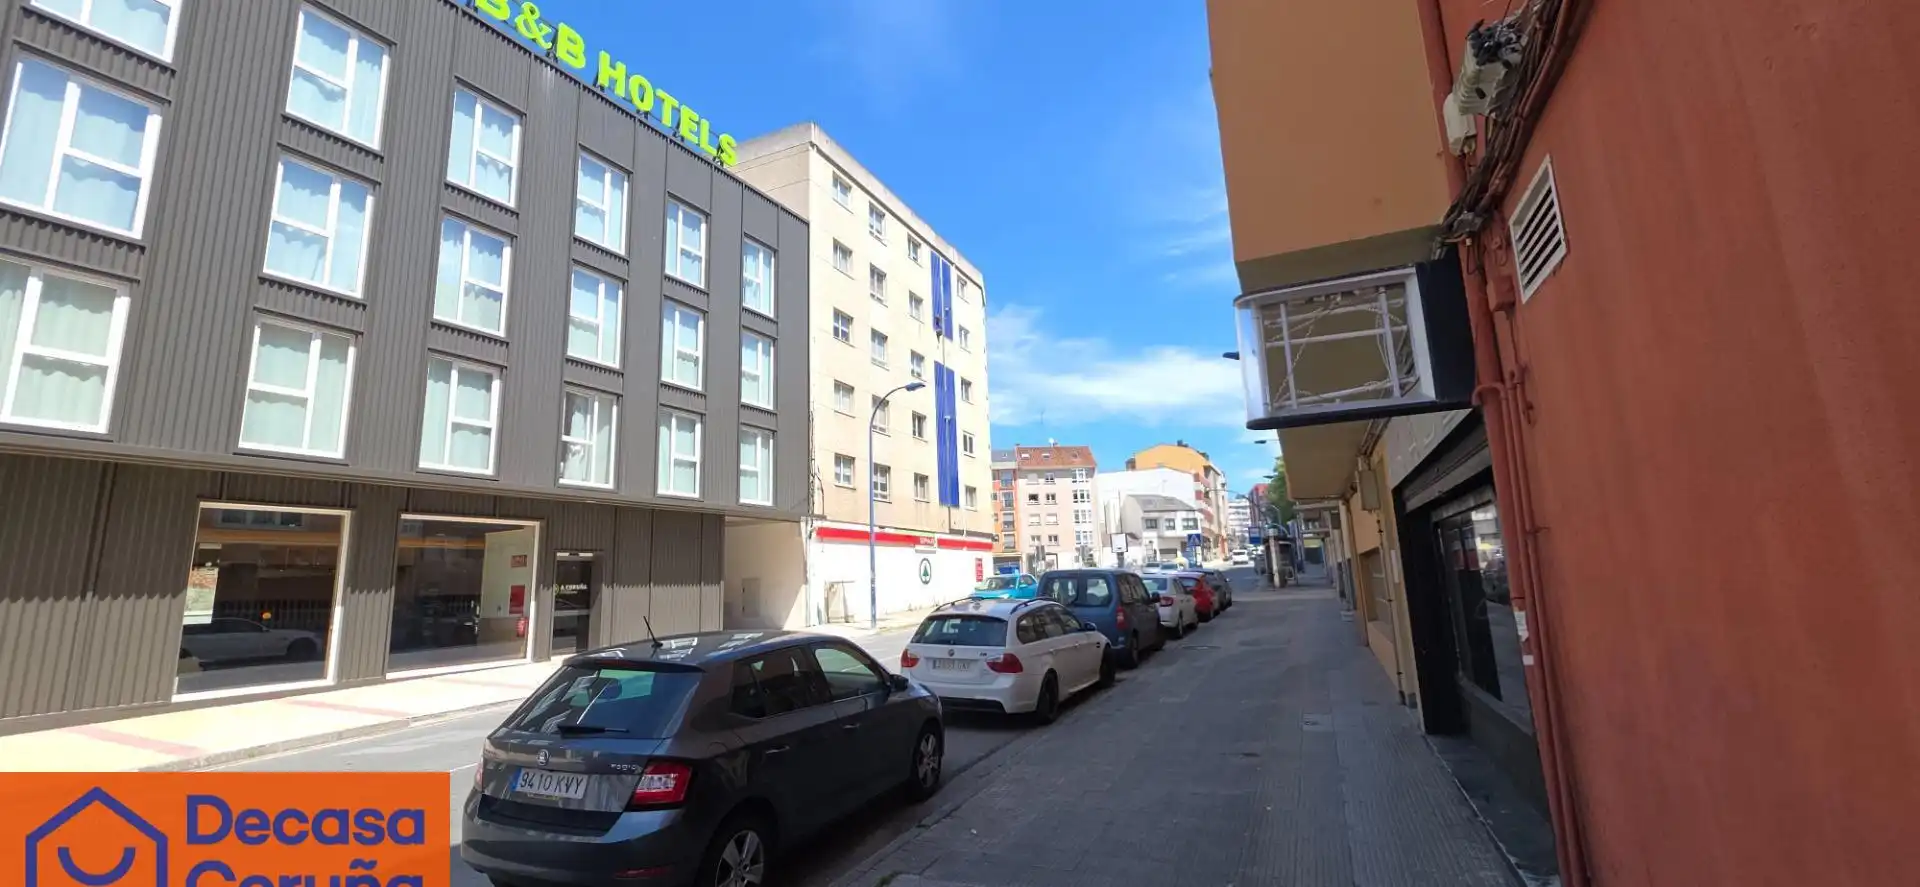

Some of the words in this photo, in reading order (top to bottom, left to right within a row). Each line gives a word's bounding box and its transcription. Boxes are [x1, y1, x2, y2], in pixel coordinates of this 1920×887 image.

[598, 50, 738, 167] HOTELS
[520, 771, 552, 791] 9410
[554, 774, 584, 795] KVY
